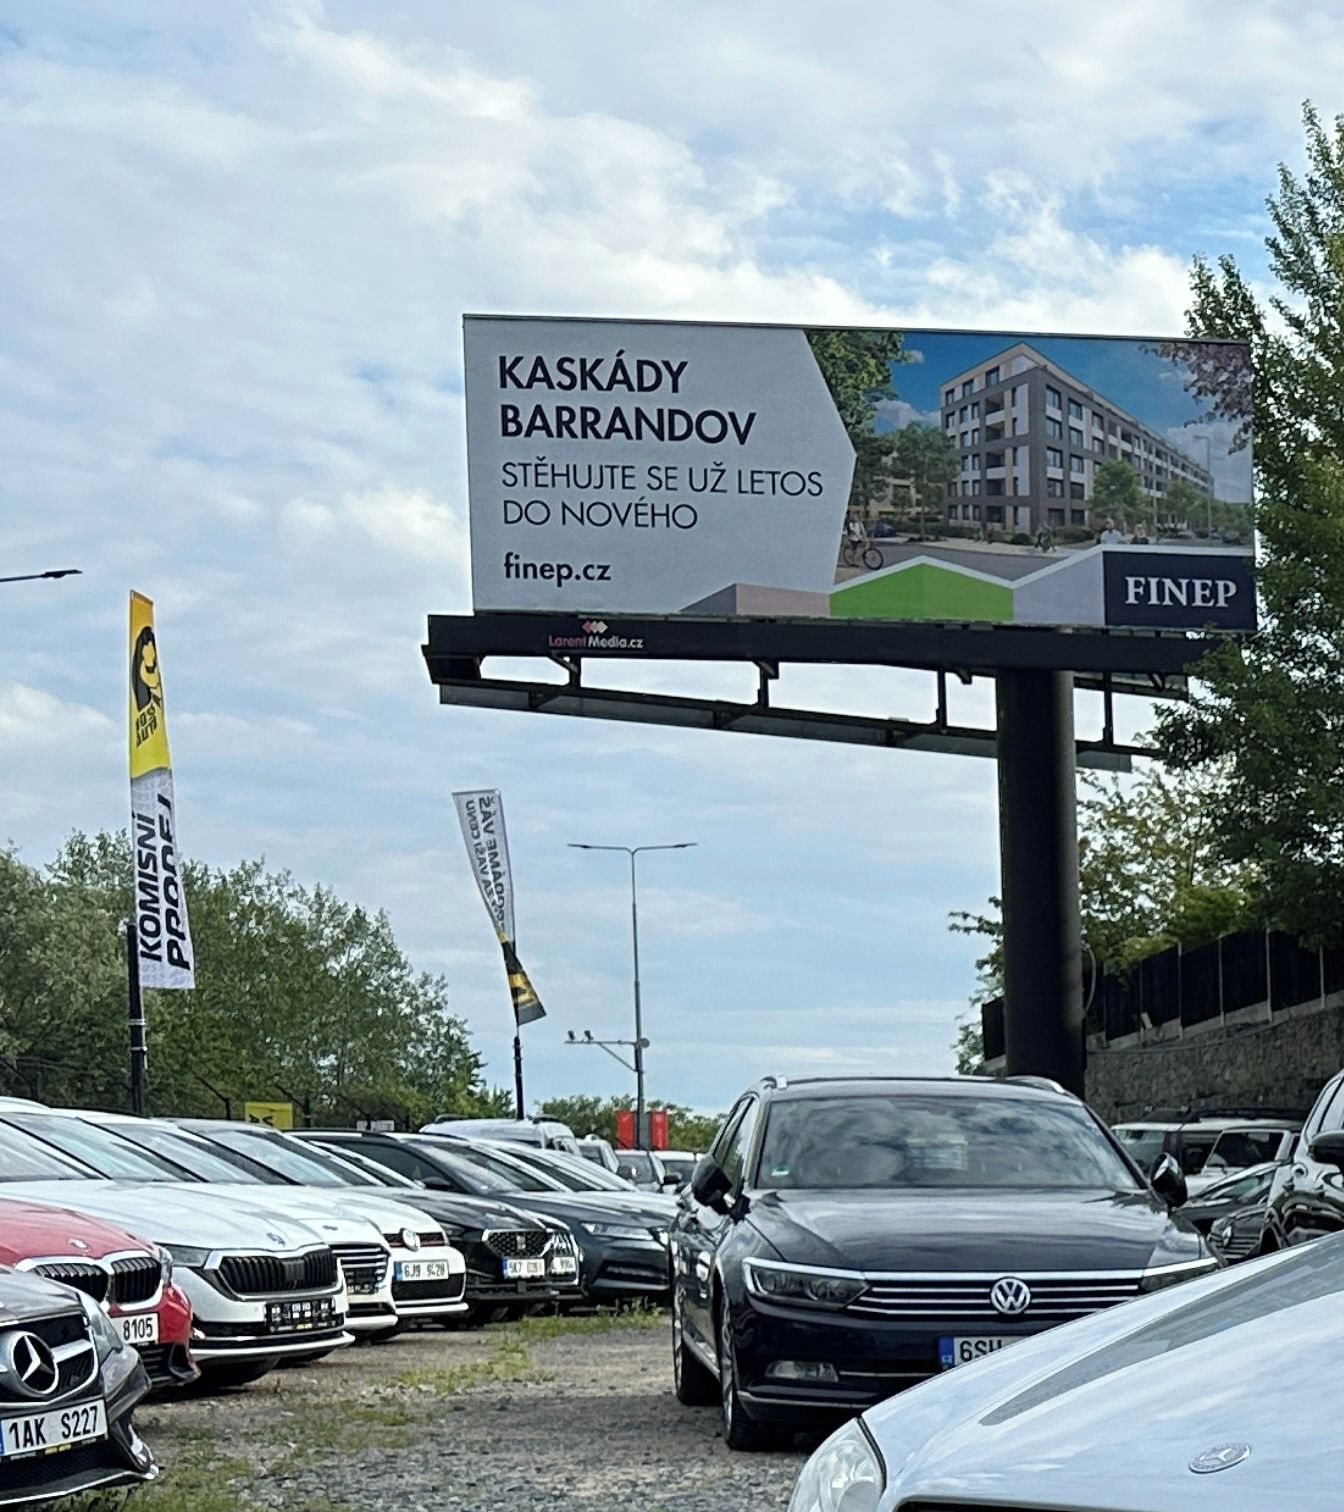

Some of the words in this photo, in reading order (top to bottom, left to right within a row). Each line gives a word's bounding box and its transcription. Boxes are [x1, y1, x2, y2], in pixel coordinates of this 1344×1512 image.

[499, 349, 688, 394] KASKÁDY
[500, 404, 757, 446] BARRANDOV
[502, 456, 636, 490] STĚHUJTE
[646, 466, 678, 491] SE
[688, 461, 728, 494] UŽ
[737, 469, 823, 497] LETOS
[503, 500, 551, 525] DO
[561, 496, 698, 529] NOVÉHO
[503, 552, 611, 587] finep.cz
[1125, 576, 1237, 607] FINEP
[131, 807, 162, 962] KOMISNÍ
[122, 1318, 153, 1341] 8105
[9, 1417, 47, 1449] 1AK
[61, 1406, 98, 1439] S227
